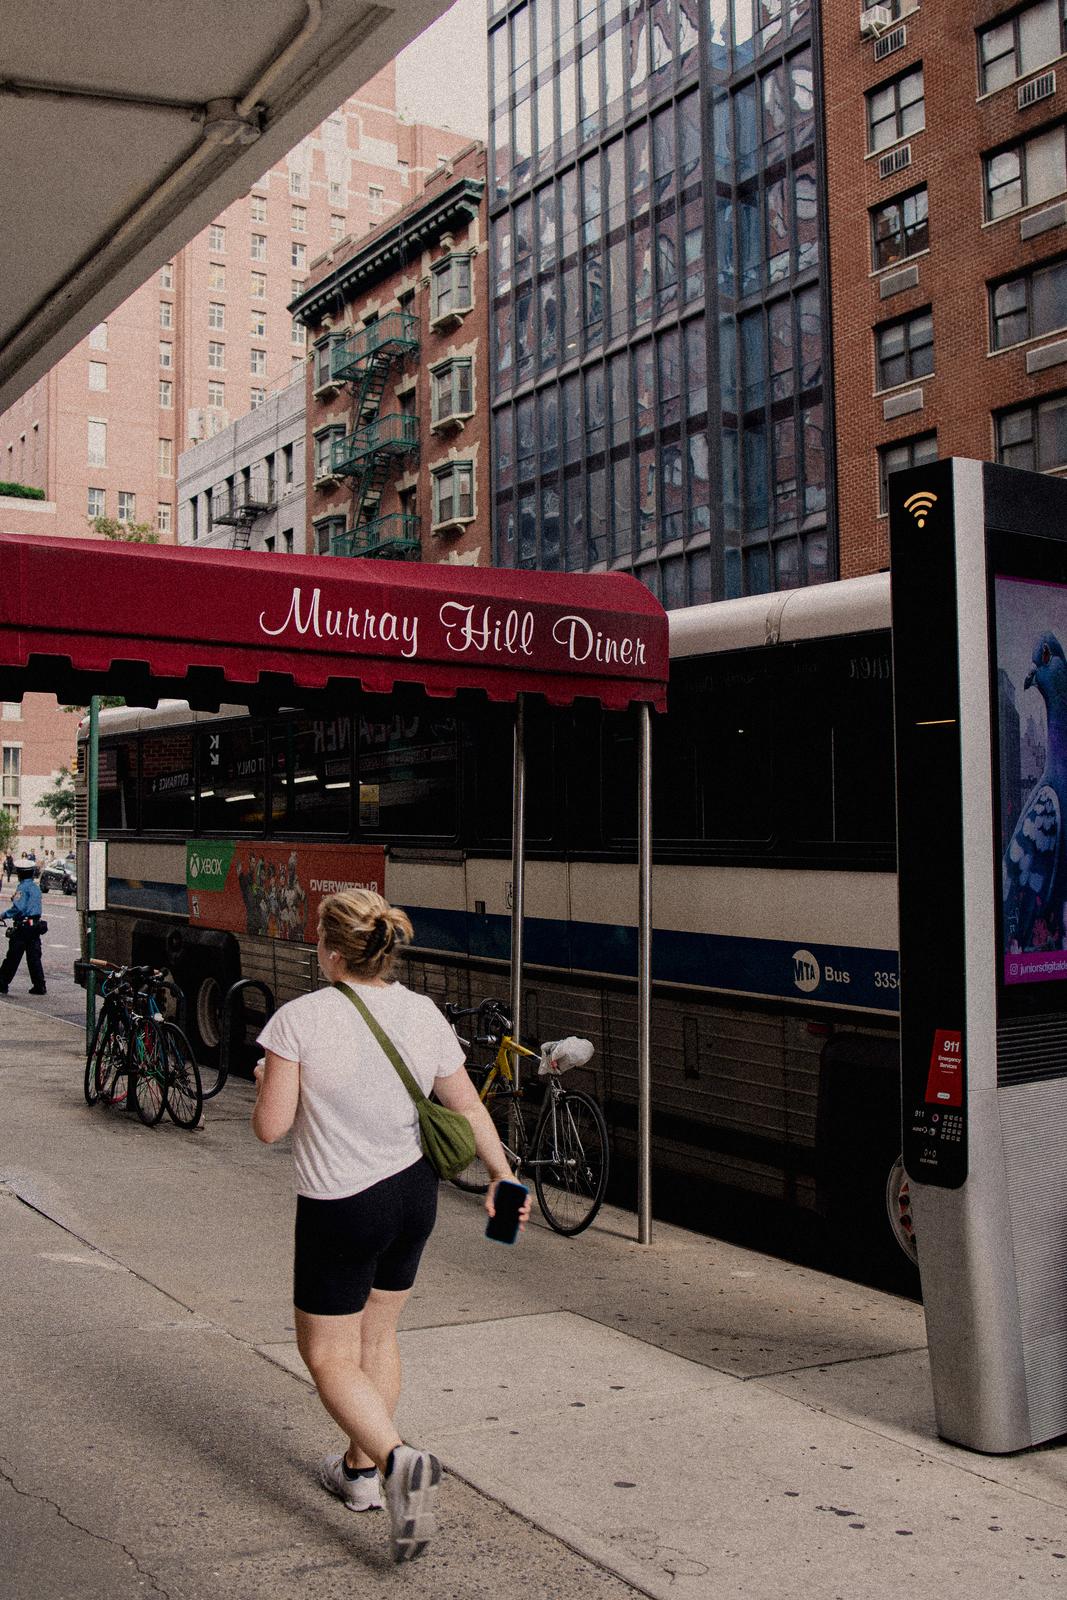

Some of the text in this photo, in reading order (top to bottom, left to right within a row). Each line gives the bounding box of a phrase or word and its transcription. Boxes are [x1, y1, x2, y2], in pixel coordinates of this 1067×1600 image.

[259, 587, 647, 665] Murray Hill Diner
[200, 857, 223, 876] XBOX
[792, 958, 850, 984] MTA Bus
[874, 971, 900, 989] 335
[943, 1040, 960, 1053] 911
